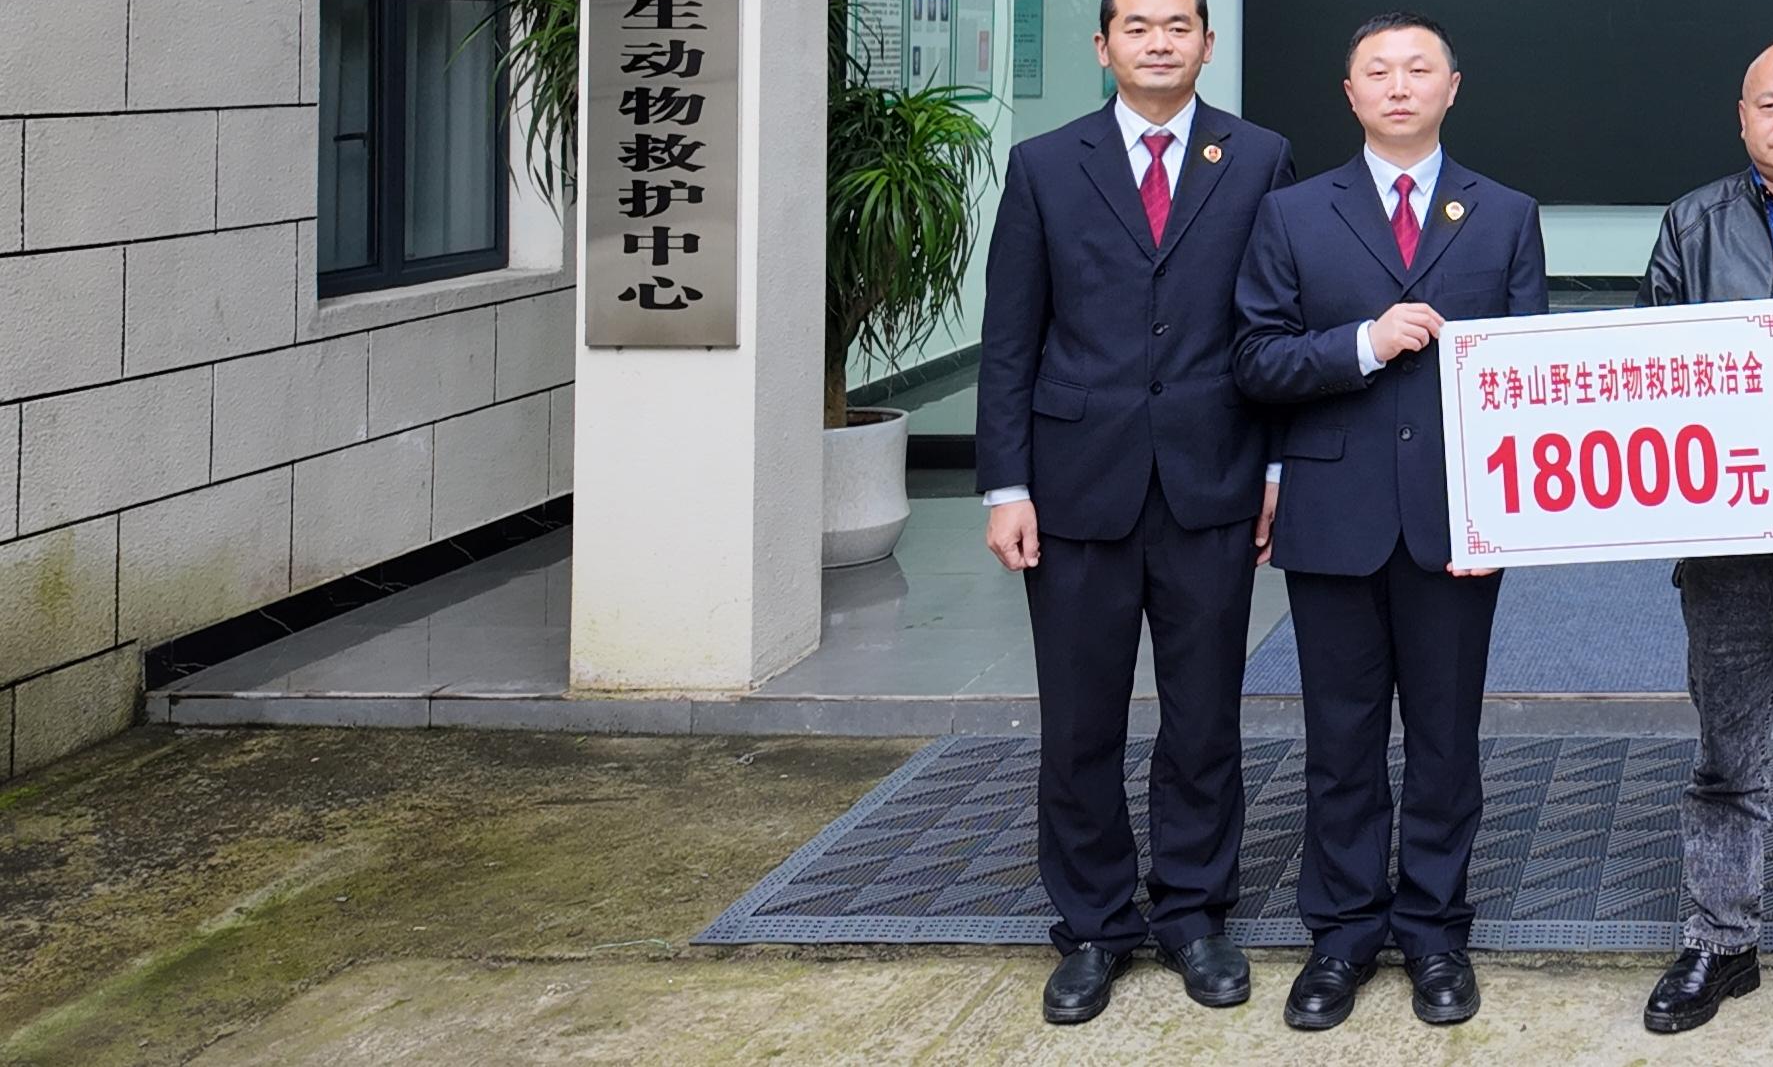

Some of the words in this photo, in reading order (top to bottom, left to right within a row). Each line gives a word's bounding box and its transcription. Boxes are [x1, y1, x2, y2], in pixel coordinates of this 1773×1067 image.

[1479, 350, 1763, 410] 梵净山野生动物救助救治金
[1487, 424, 1769, 514] 18000元
